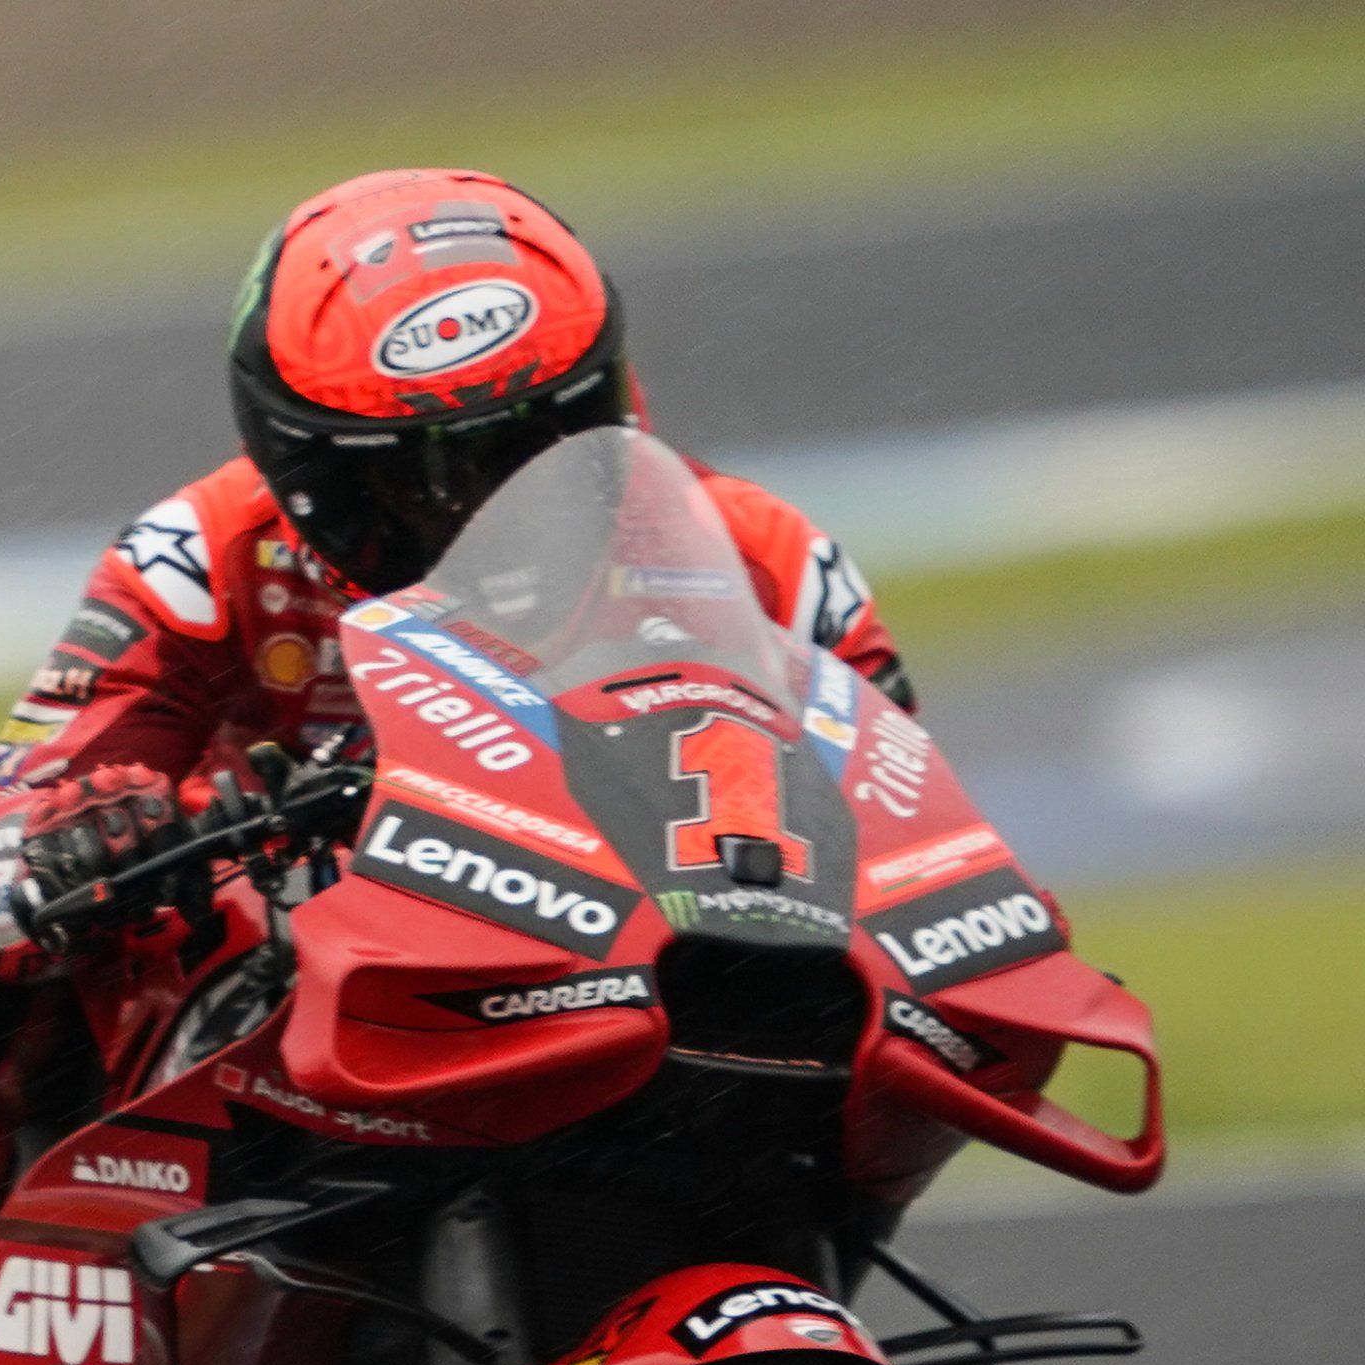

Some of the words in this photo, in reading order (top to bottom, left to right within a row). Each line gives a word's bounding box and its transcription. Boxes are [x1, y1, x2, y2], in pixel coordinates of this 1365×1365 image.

[666, 711, 815, 884] 1
[365, 815, 618, 935] Lenovo
[876, 894, 1052, 977] Lenovo
[479, 974, 650, 1019] CARRERA
[98, 1155, 191, 1193] DAIKO
